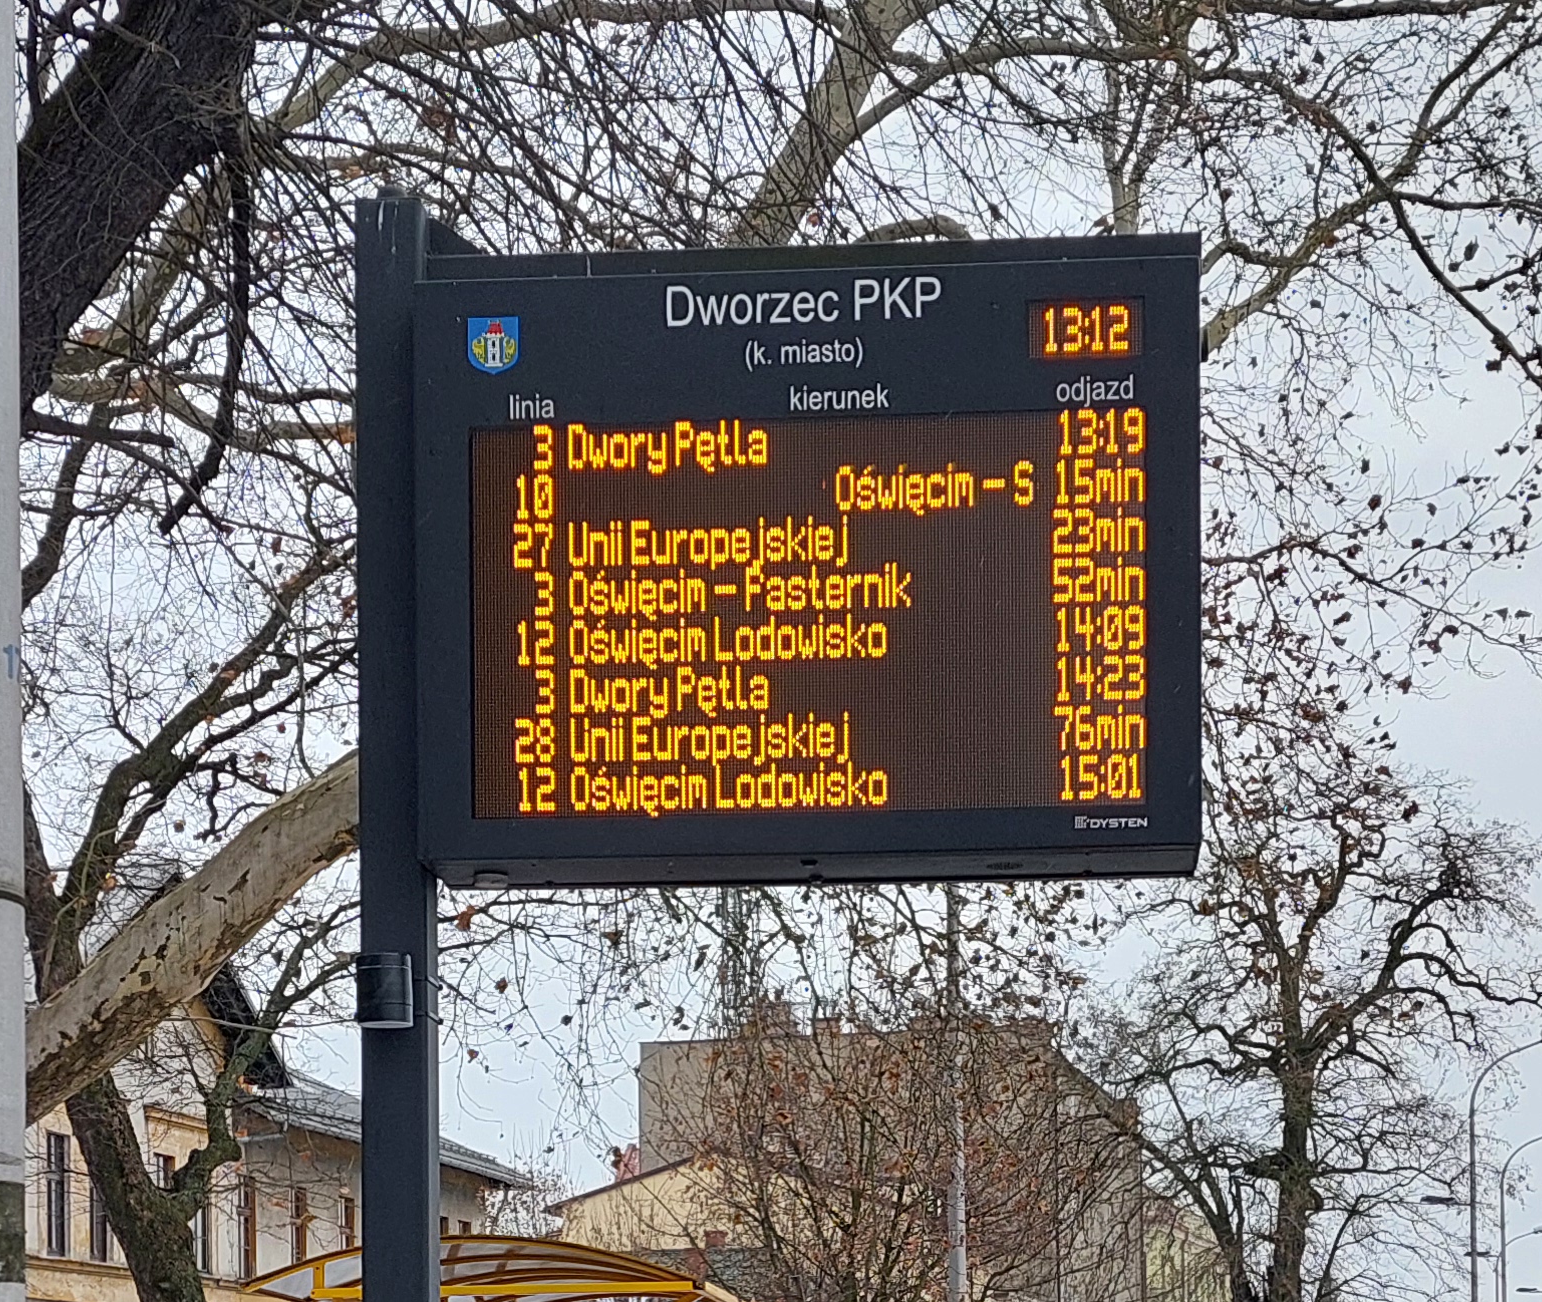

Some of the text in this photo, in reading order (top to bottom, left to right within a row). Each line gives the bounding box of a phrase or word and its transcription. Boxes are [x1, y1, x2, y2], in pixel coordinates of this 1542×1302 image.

[665, 275, 943, 328] Dworzec PKP
[1041, 304, 1130, 356] 13:12
[744, 335, 865, 373] (k. miasto)
[508, 373, 1136, 421] linia kierunek odjazd
[533, 407, 1147, 475] 3 Dwory Pętla 13:19
[515, 473, 555, 520] 10
[834, 461, 975, 517] Oświęcim
[1055, 456, 1146, 506] 15min
[512, 506, 1146, 571] 27 Unii Europejskiej 23min
[534, 570, 554, 617] 3
[568, 568, 707, 621] Oświęcim
[1050, 556, 1146, 605] 52min
[516, 604, 1147, 671] 12 Oświęcim Lodowisko 14:09
[534, 654, 1147, 720] 3 Dwory Pętla 14:23
[514, 704, 1147, 767] 28 Unii Europejskiej 76min
[517, 752, 1144, 819] 12 Oświęcim Lodowisko 15:01
[1089, 816, 1149, 830] DYSTEN
